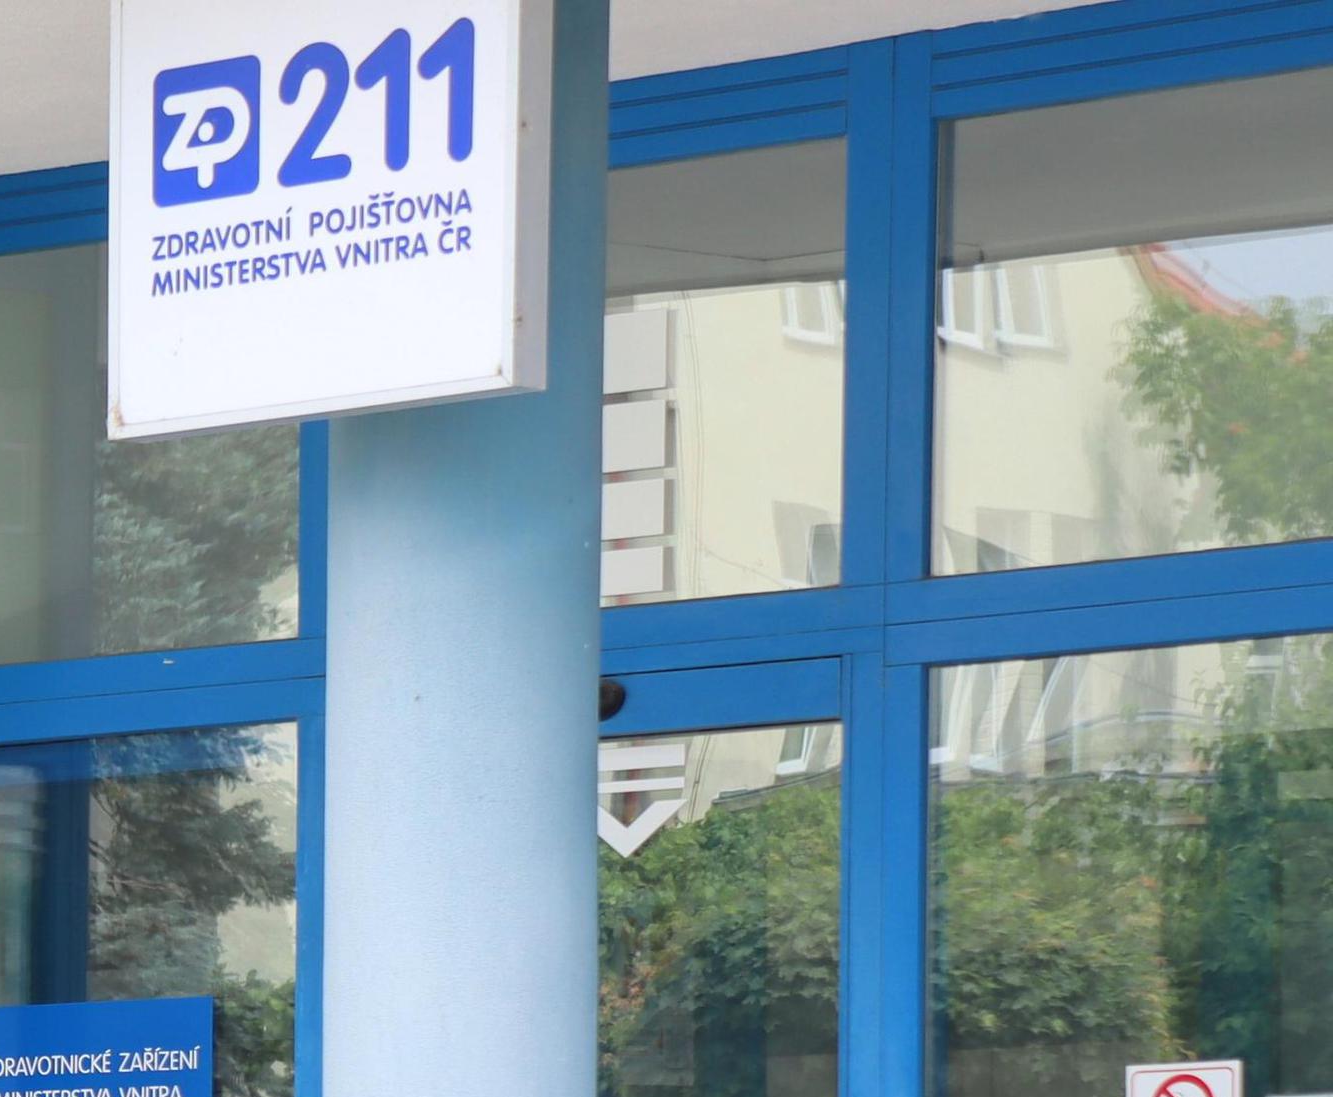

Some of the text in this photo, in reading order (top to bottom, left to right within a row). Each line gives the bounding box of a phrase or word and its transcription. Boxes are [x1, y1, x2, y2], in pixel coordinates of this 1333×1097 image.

[277, 16, 475, 188] 211
[151, 220, 472, 297] MINISTERSTVA VNITRA ČR
[152, 188, 473, 261] ZDRAVOTNÍ POJIŠŤOVNA
[118, 1045, 200, 1073] ZAŘÍZENÍ
